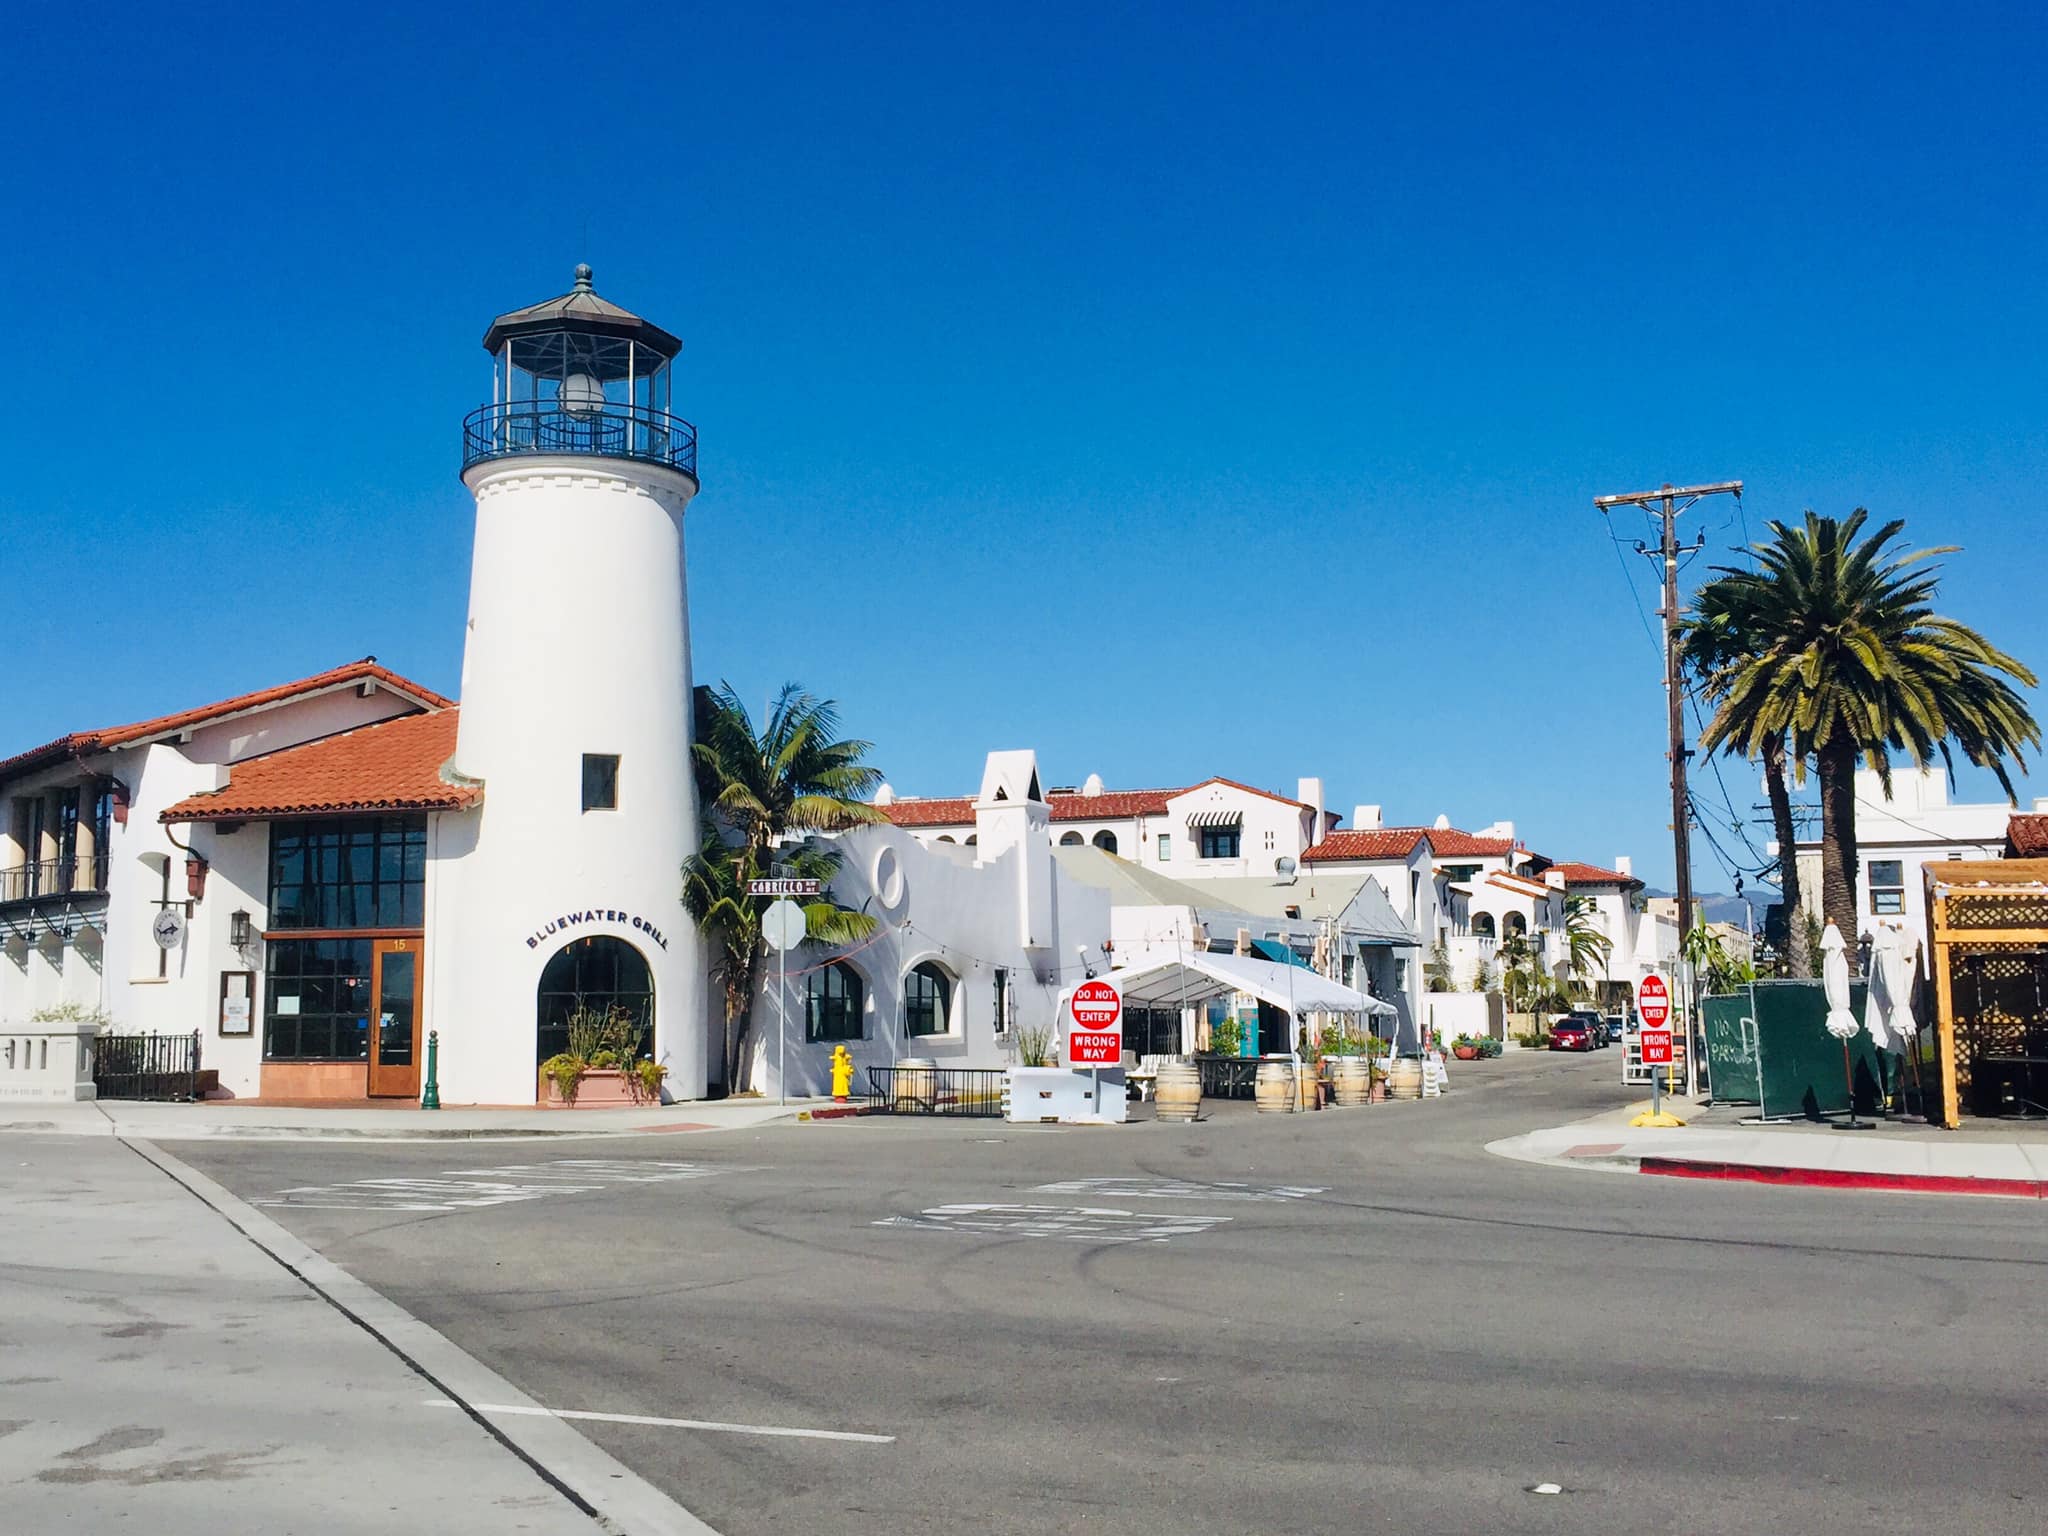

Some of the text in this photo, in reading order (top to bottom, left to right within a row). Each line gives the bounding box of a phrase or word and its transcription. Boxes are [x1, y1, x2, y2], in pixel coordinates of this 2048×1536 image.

[751, 881, 803, 893] CABRILLO
[526, 909, 669, 952] BLUEWATER GRILL
[394, 939, 406, 950] 15
[1641, 984, 1664, 994] DO NOT
[1077, 990, 1114, 1000] DO NOT
[1080, 1012, 1111, 1021] ENTER
[1645, 1008, 1664, 1018] ENTER
[1714, 1019, 1729, 1038] NO
[1074, 1036, 1116, 1047] WRONG
[1643, 1034, 1669, 1046] WRONG
[1082, 1048, 1107, 1059] WAY
[1649, 1047, 1664, 1059] WAY
